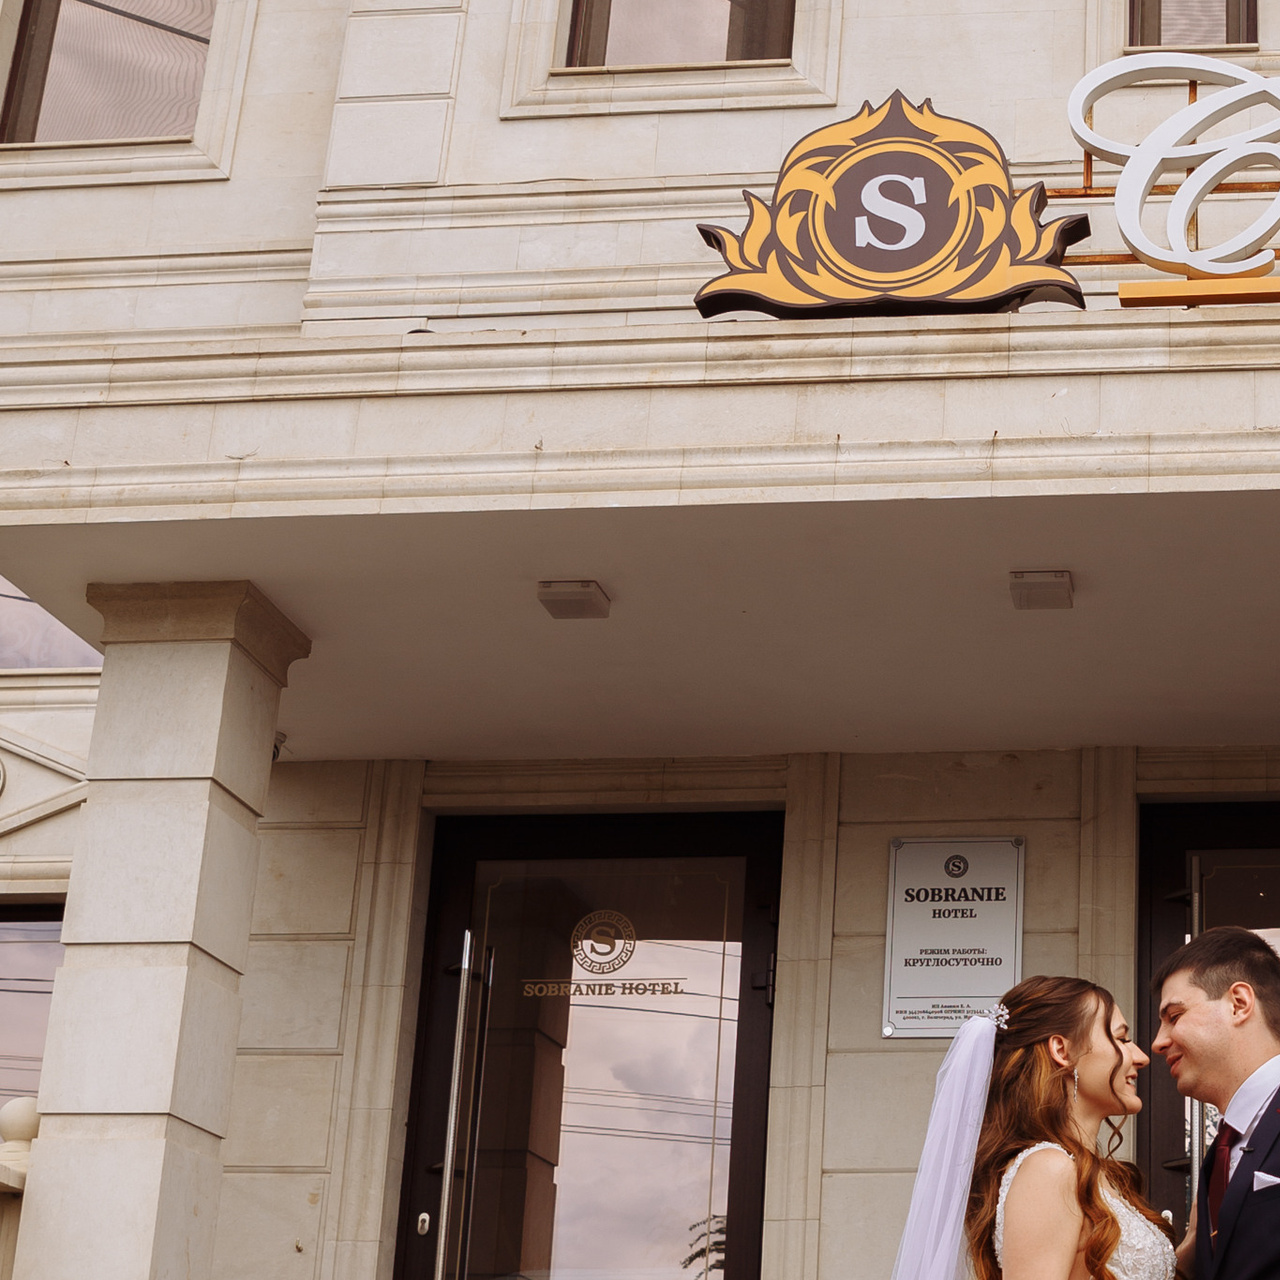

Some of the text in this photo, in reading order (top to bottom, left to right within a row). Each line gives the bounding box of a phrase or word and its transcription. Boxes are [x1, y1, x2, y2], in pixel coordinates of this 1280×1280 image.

[855, 173, 927, 252] S
[904, 887, 1007, 903] SOBRANIE
[931, 908, 977, 919] HOTEL
[590, 926, 617, 956] S
[904, 957, 1003, 967] КРУГЛОСУТОЧНО
[523, 981, 685, 997] SOBRANIE HOTEL
